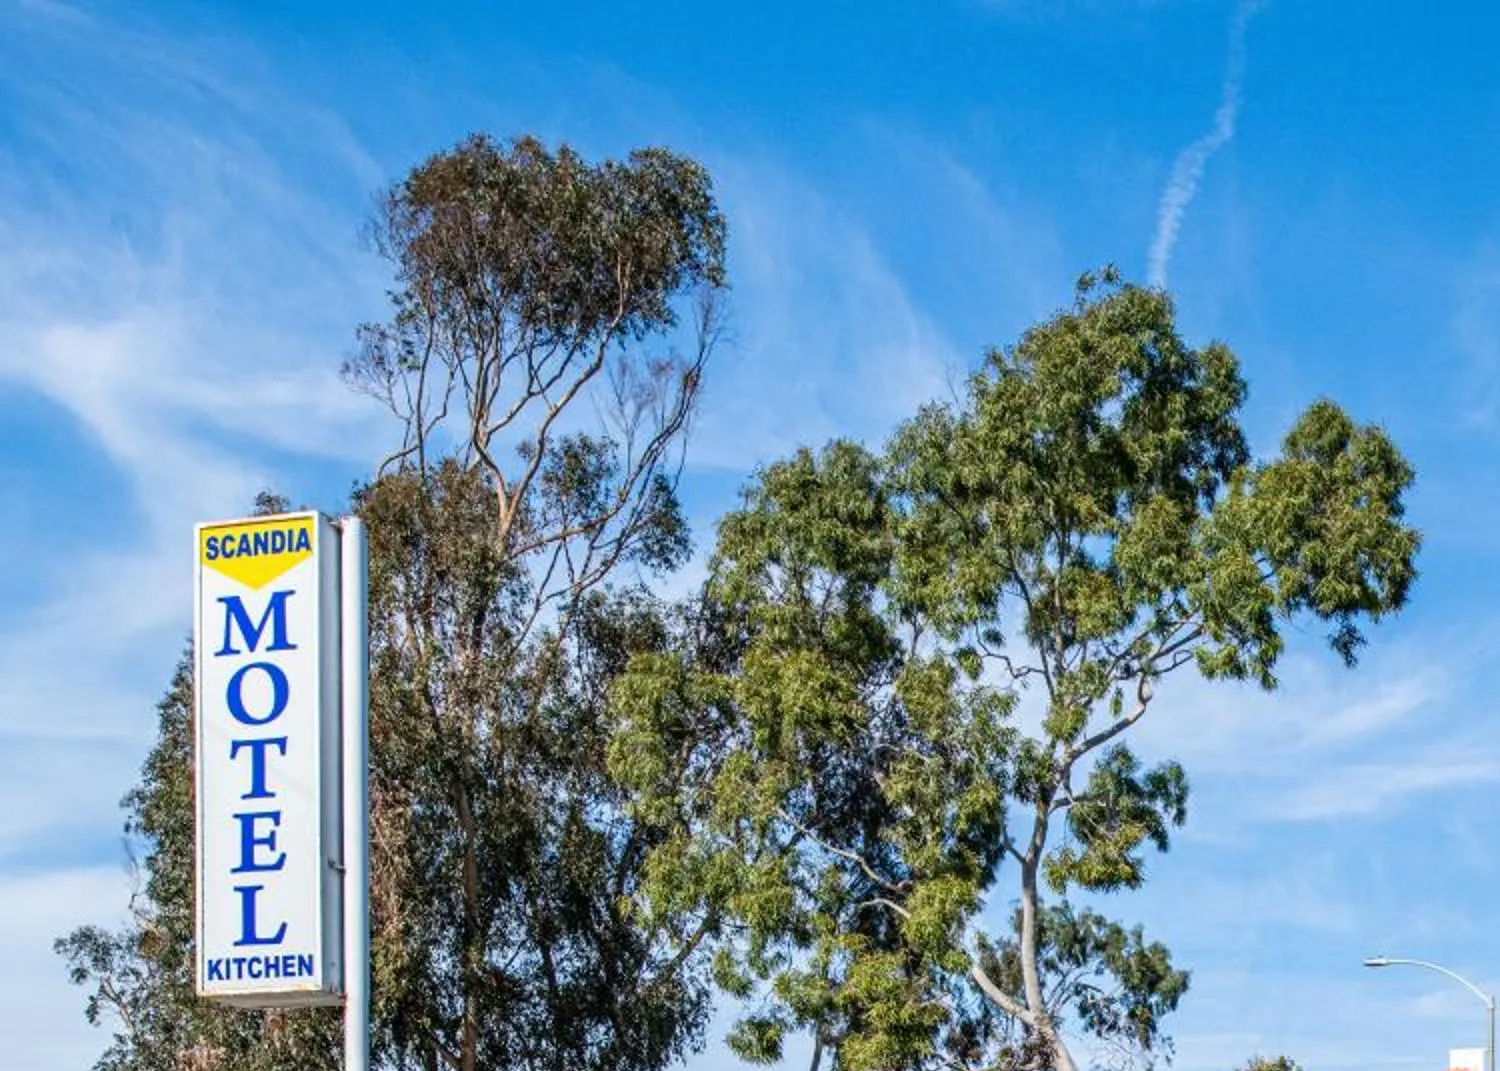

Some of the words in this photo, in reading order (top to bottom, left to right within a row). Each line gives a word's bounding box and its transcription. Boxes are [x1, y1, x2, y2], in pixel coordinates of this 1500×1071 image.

[205, 527, 312, 561] SCANDIA
[214, 589, 298, 947] MOTEL
[207, 954, 314, 981] KITCHEN
